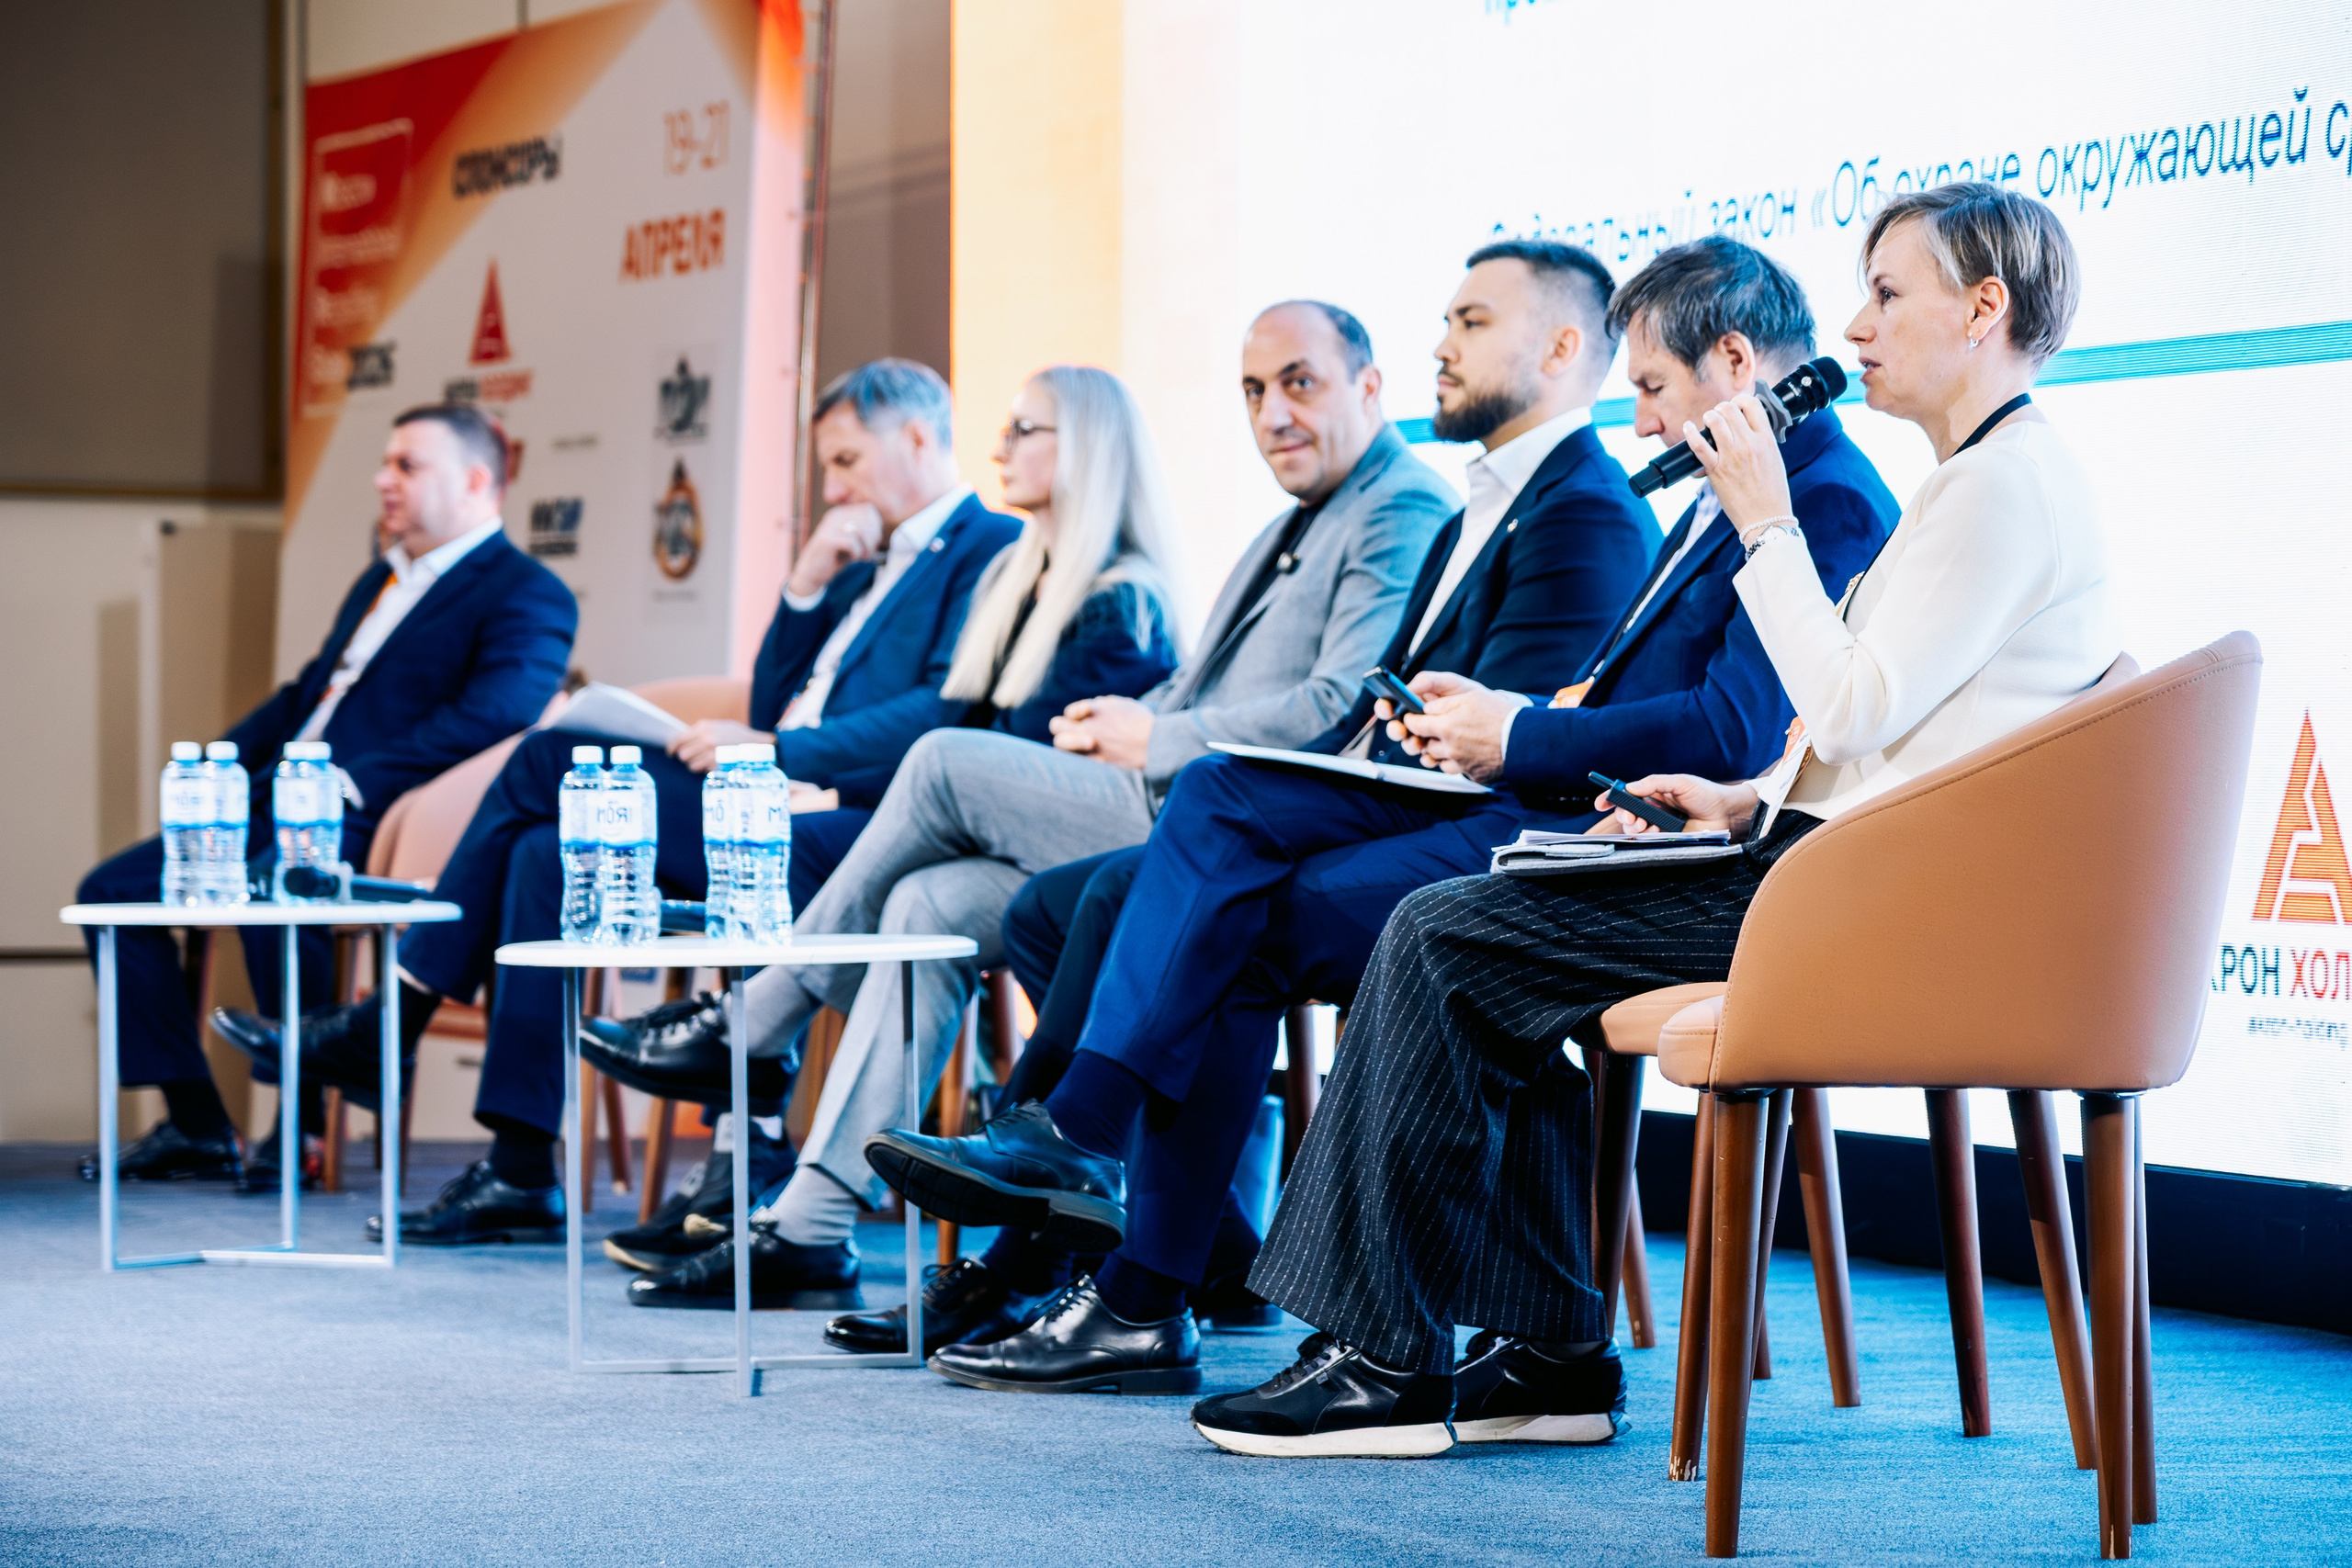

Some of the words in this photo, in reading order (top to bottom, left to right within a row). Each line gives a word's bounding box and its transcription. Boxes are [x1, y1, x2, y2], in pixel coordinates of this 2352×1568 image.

[1710, 186, 1799, 239] закон
[2037, 85, 2312, 213] окружающей
[2326, 99, 2352, 176] с
[620, 209, 727, 283] АПРЕЛЯ
[2211, 943, 2280, 998] РОН
